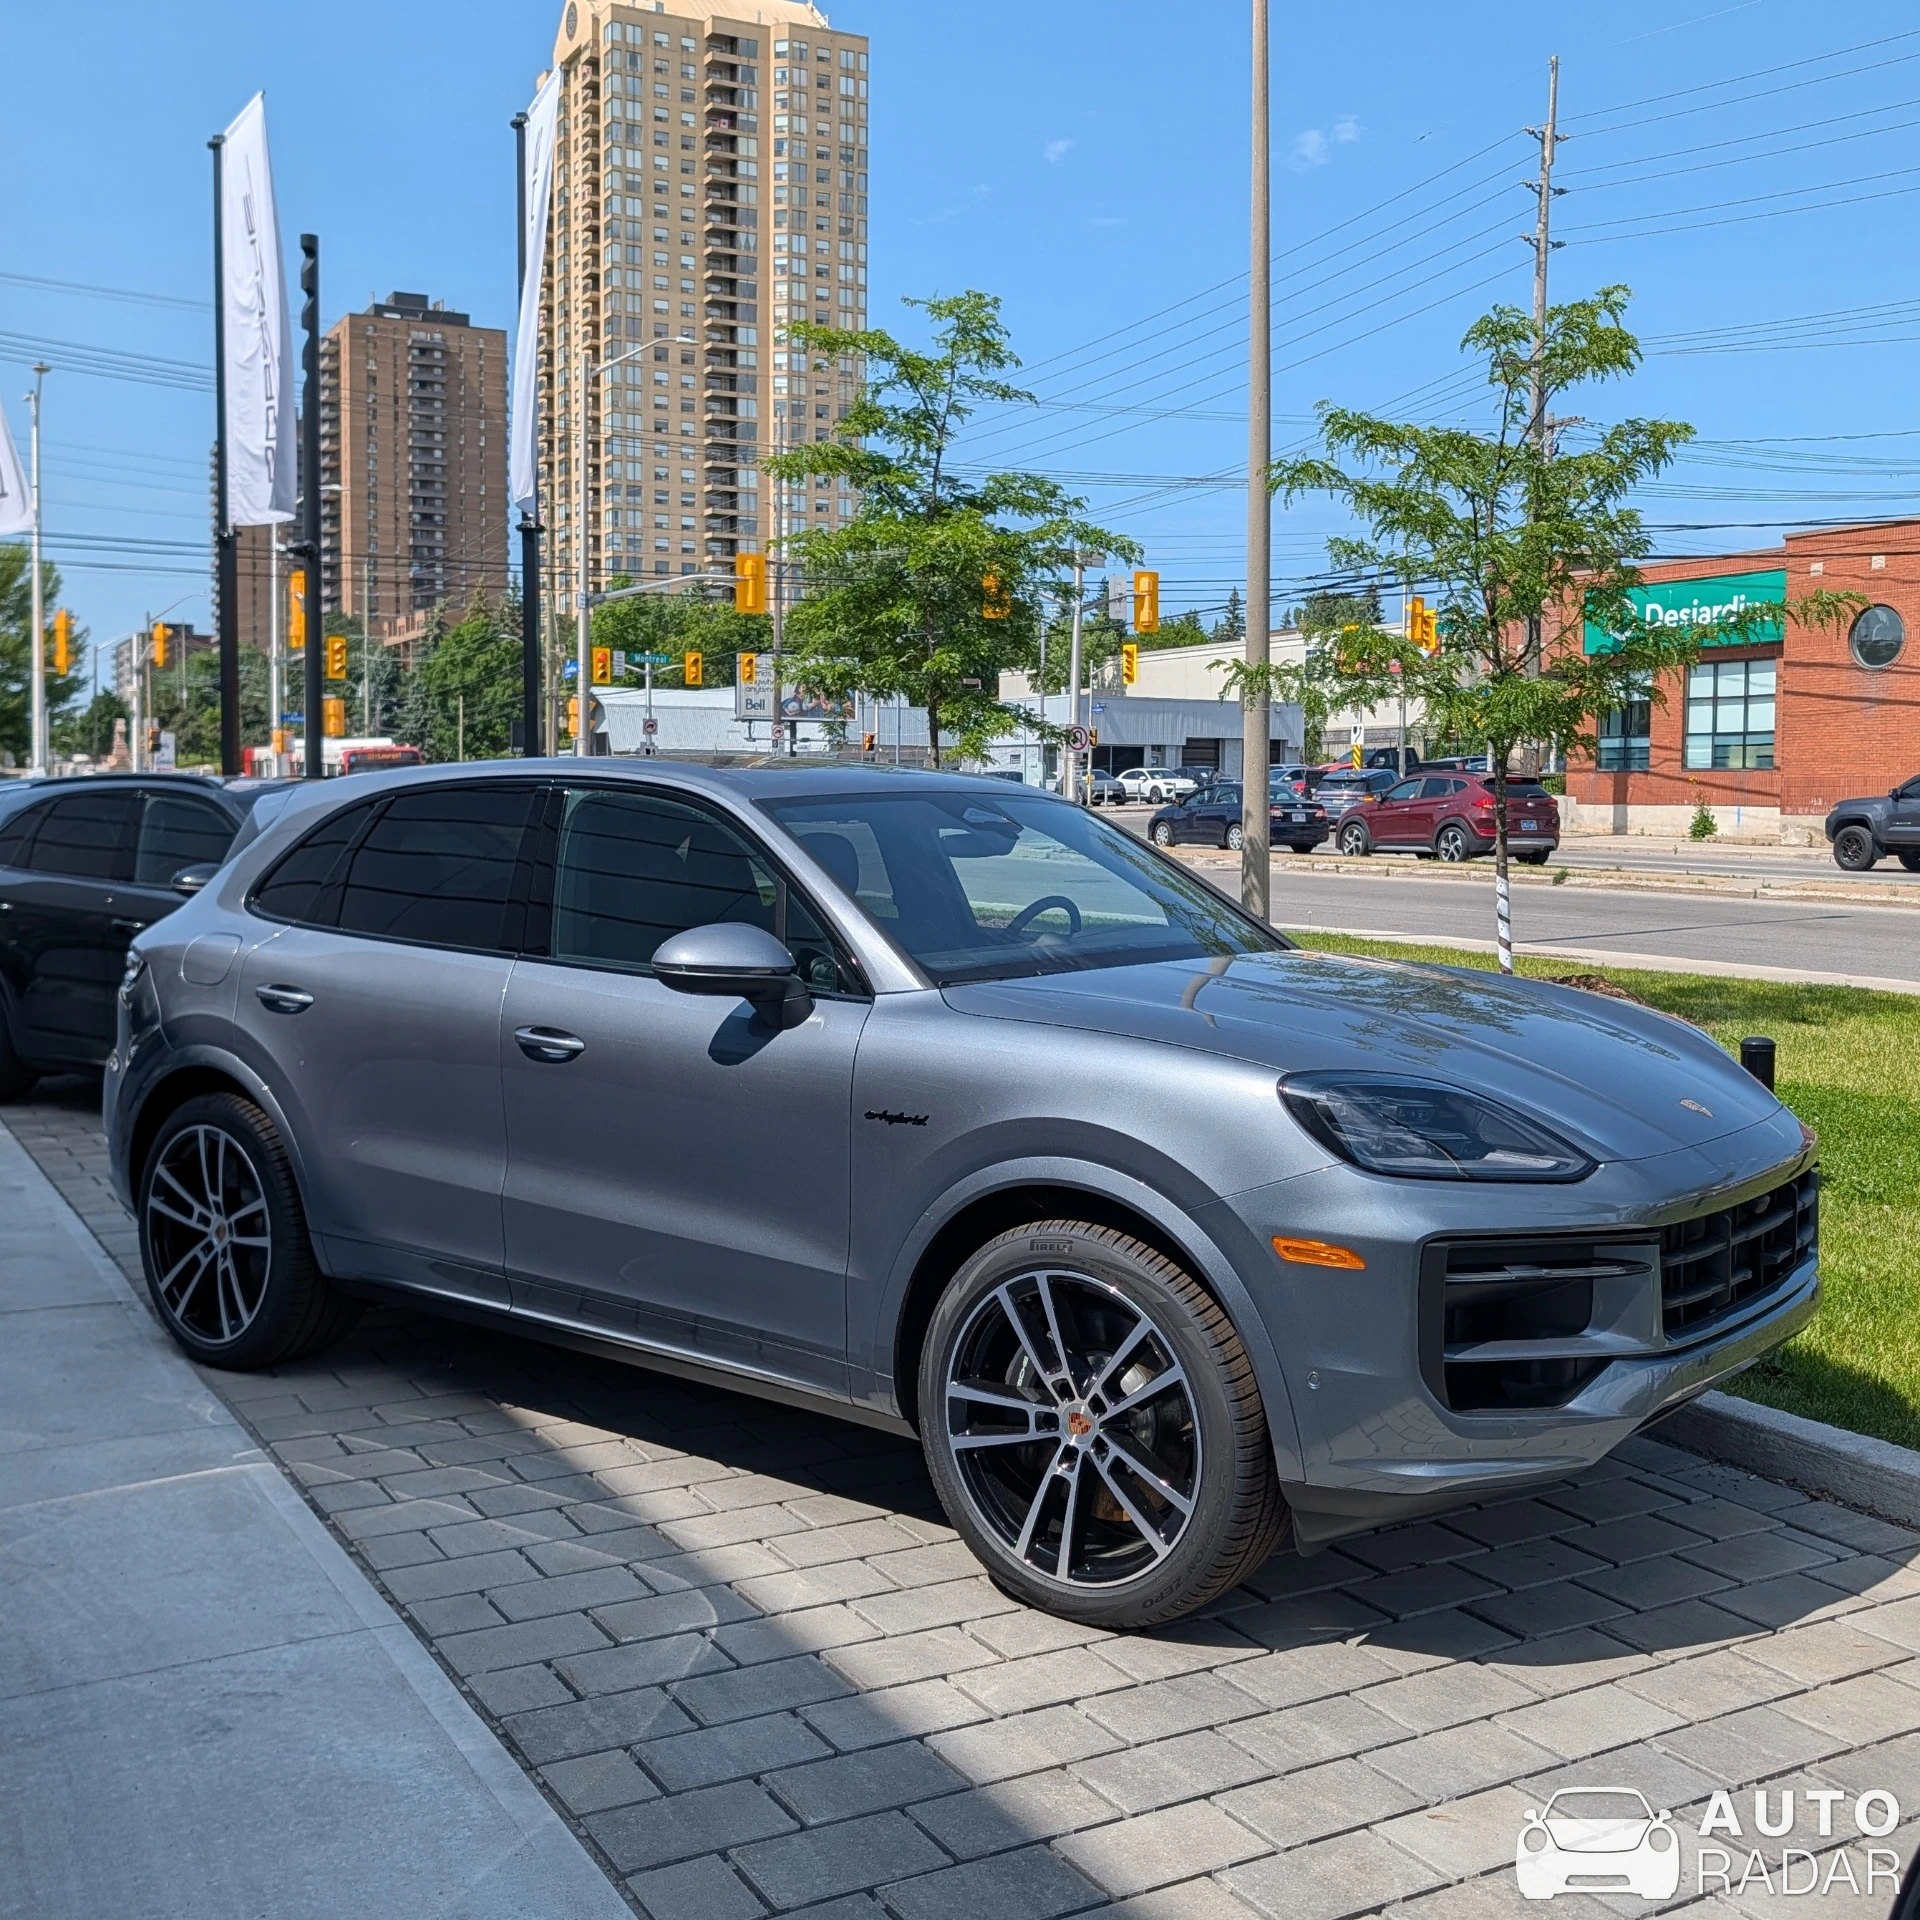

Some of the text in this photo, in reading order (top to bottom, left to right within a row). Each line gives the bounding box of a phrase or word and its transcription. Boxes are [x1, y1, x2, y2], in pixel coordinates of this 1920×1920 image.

[1645, 594, 1775, 630] Desjardi
[634, 653, 667, 663] Montreal
[745, 686, 774, 694] anytim
[745, 698, 766, 710] Bell
[1029, 1238, 1074, 1251] PIRELLI
[1186, 1474, 1228, 1572] SCORPION
[1142, 1575, 1184, 1609] ZERO
